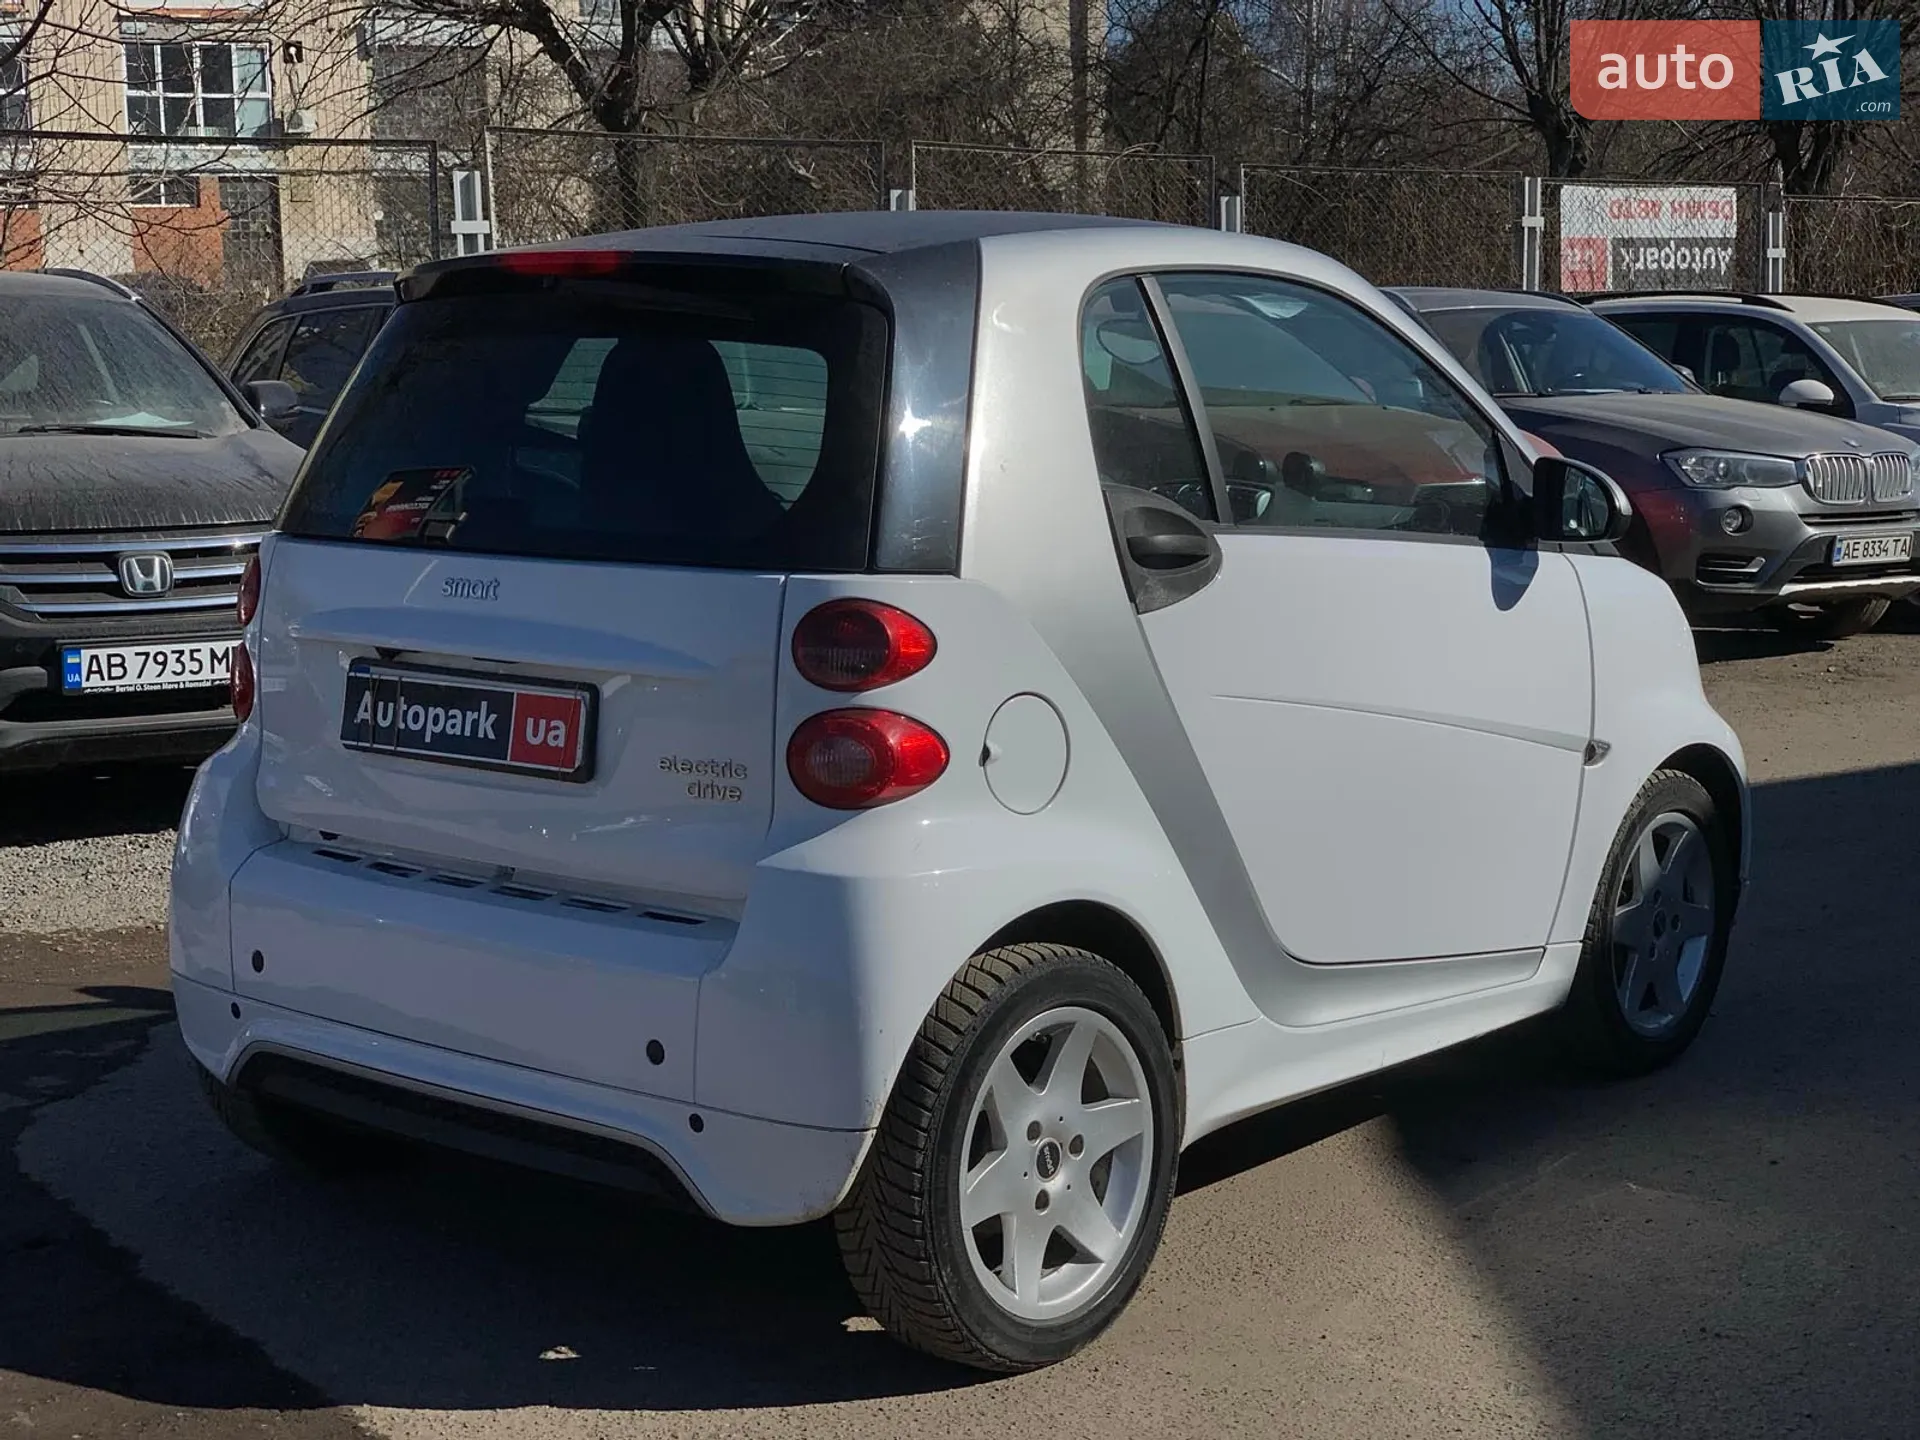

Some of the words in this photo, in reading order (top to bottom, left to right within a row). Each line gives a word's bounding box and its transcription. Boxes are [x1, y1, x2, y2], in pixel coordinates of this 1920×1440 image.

[1620, 240, 1732, 280] Autopark
[1842, 541, 1860, 559] AE
[1862, 540, 1890, 558] 8334
[1893, 538, 1908, 556] TA
[441, 577, 500, 601] smart
[85, 653, 128, 682] AB
[134, 648, 203, 678] 7935
[209, 646, 238, 674] M
[67, 673, 81, 683] UA
[355, 689, 498, 743] Autopark
[525, 716, 567, 748] ua
[659, 755, 748, 780] electric
[687, 780, 742, 803] drive
